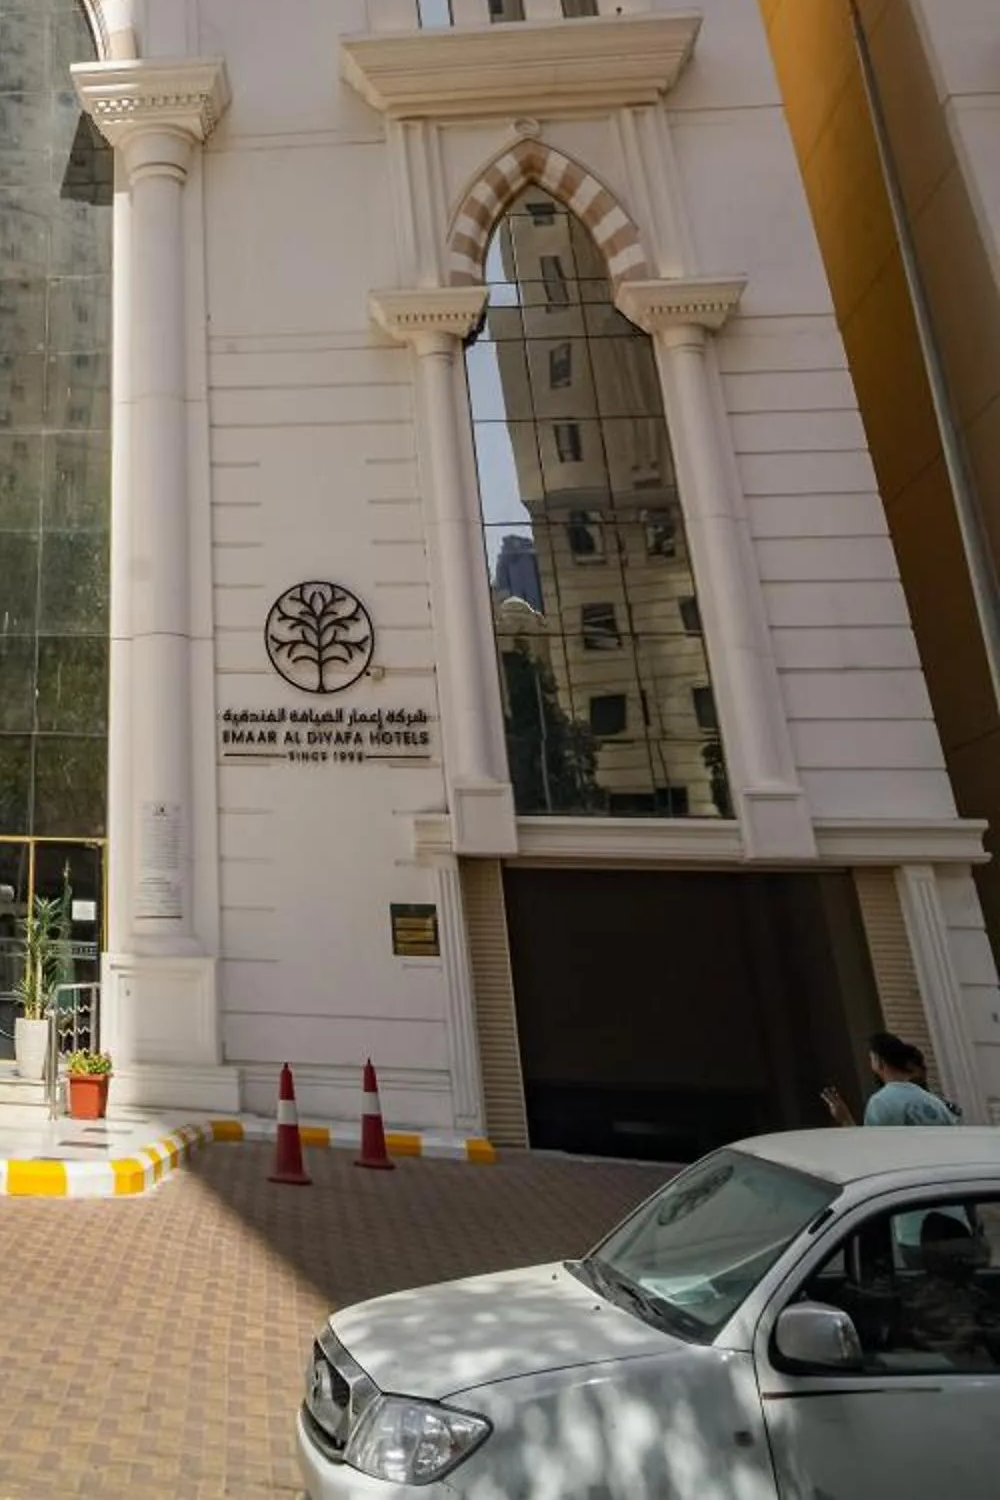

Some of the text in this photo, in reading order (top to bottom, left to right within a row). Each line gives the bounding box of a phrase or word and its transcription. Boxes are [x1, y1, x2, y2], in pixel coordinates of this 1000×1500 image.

[222, 708, 286, 727] الفندقية
[290, 708, 344, 726] الضيافة
[385, 709, 427, 728] شركة
[222, 731, 430, 746] EMAAR AL DIYAFA HOTELS
[288, 751, 328, 762] SINCE
